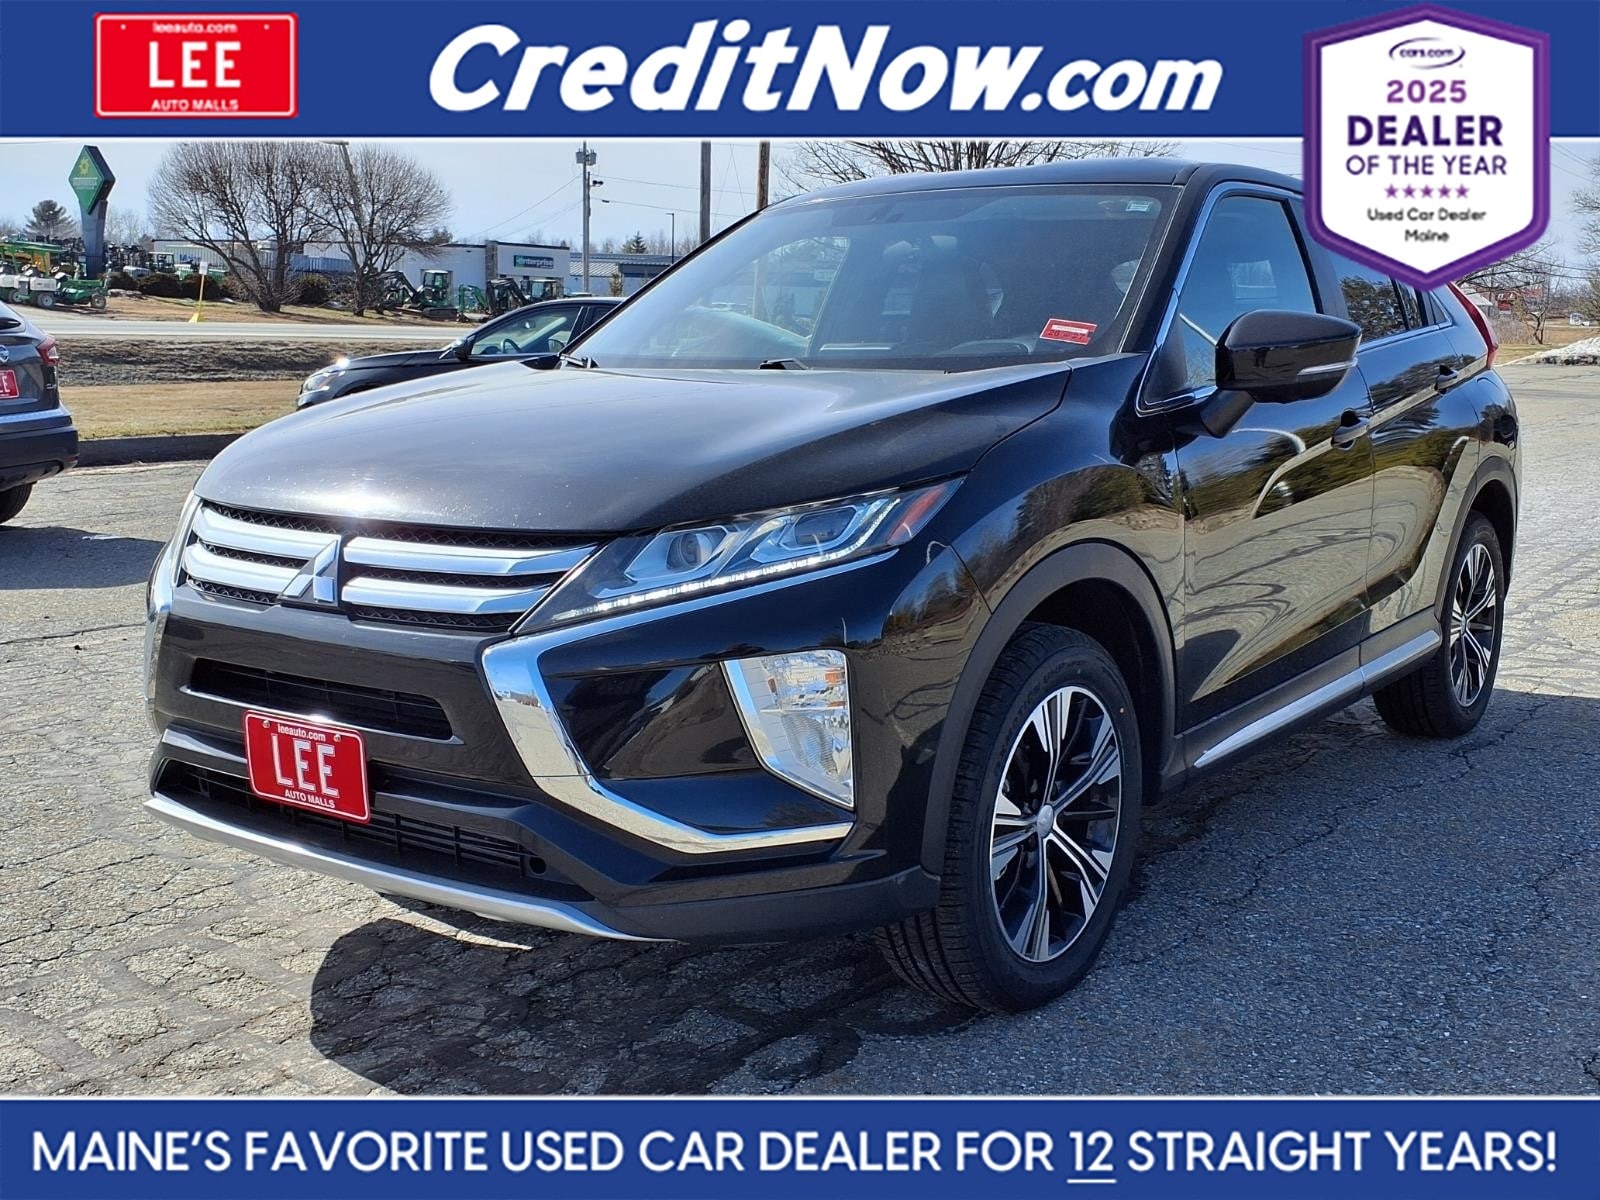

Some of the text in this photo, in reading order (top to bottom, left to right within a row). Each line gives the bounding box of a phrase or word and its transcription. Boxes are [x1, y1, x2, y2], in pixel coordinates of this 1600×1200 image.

[277, 723, 326, 742] leeauto.com
[271, 733, 340, 798] LEE
[284, 789, 336, 809] AUTO MALLS
